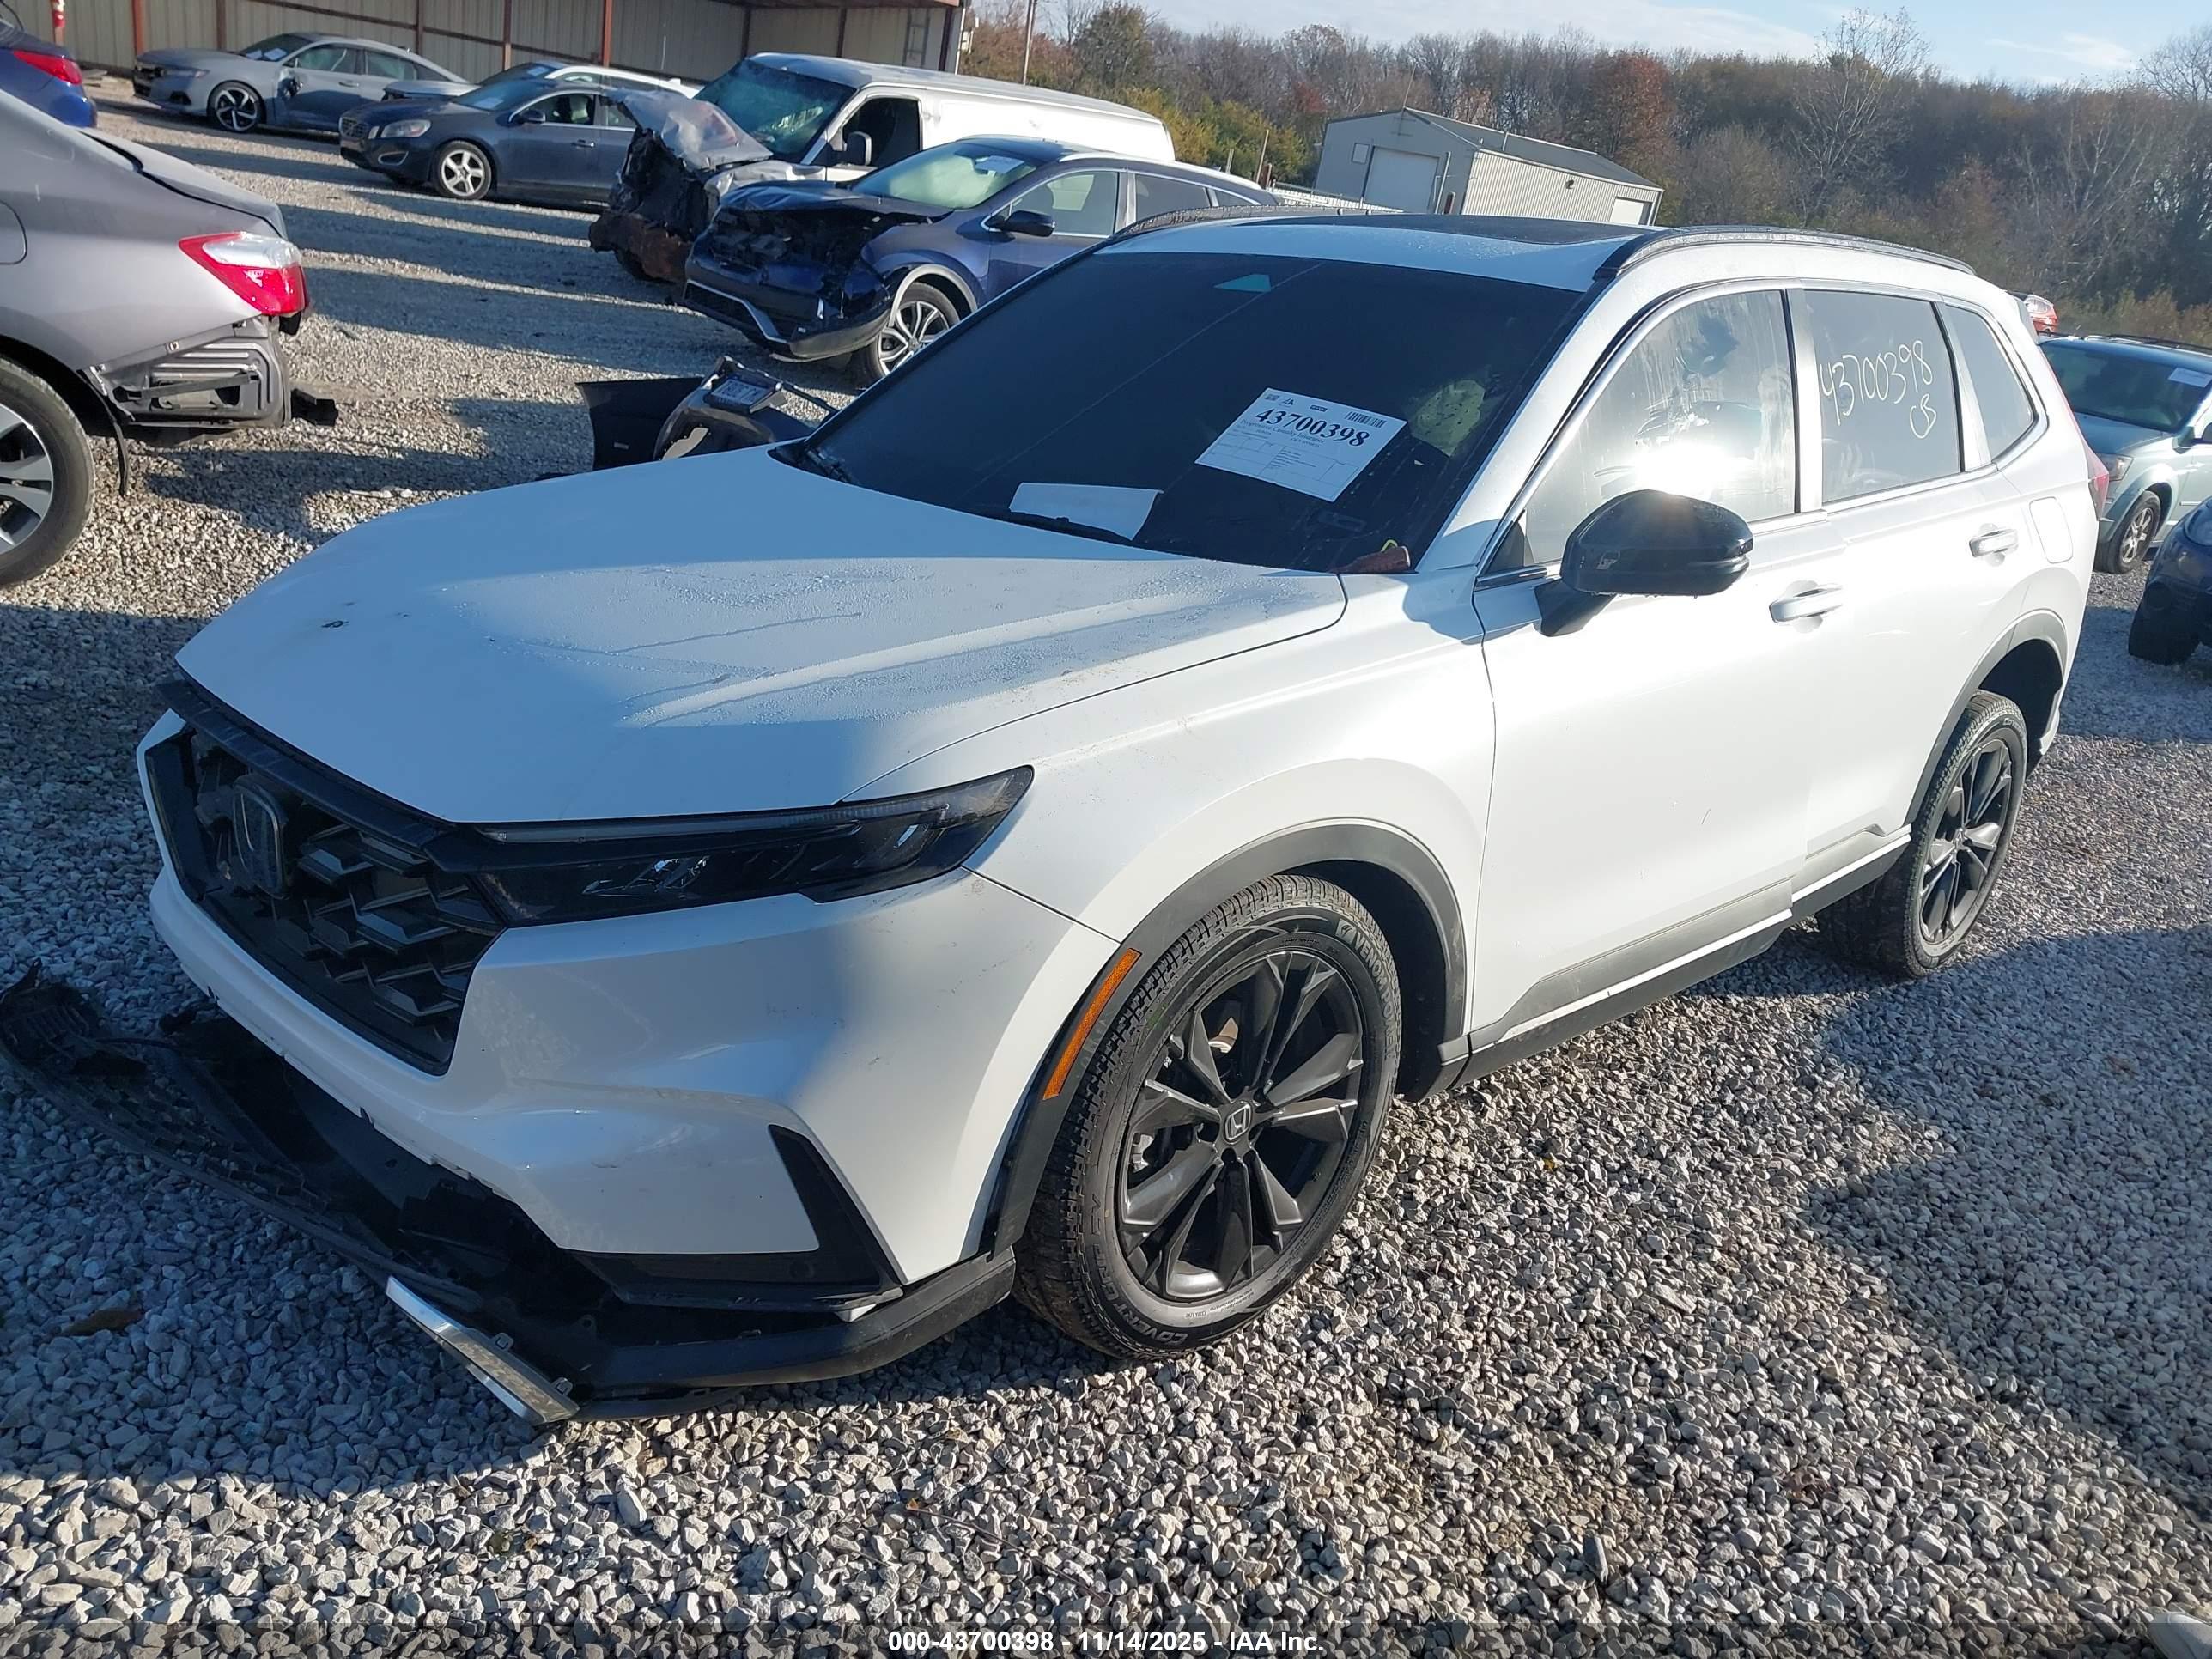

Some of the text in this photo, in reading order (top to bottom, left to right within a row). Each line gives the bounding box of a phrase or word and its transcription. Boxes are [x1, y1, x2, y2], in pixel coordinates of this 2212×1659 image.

[1820, 340, 1933, 426] 43700398
[1255, 408, 1370, 447] 43700398
[1355, 932, 1389, 991] VENOM
[1114, 1304, 1188, 1346] COVERT
